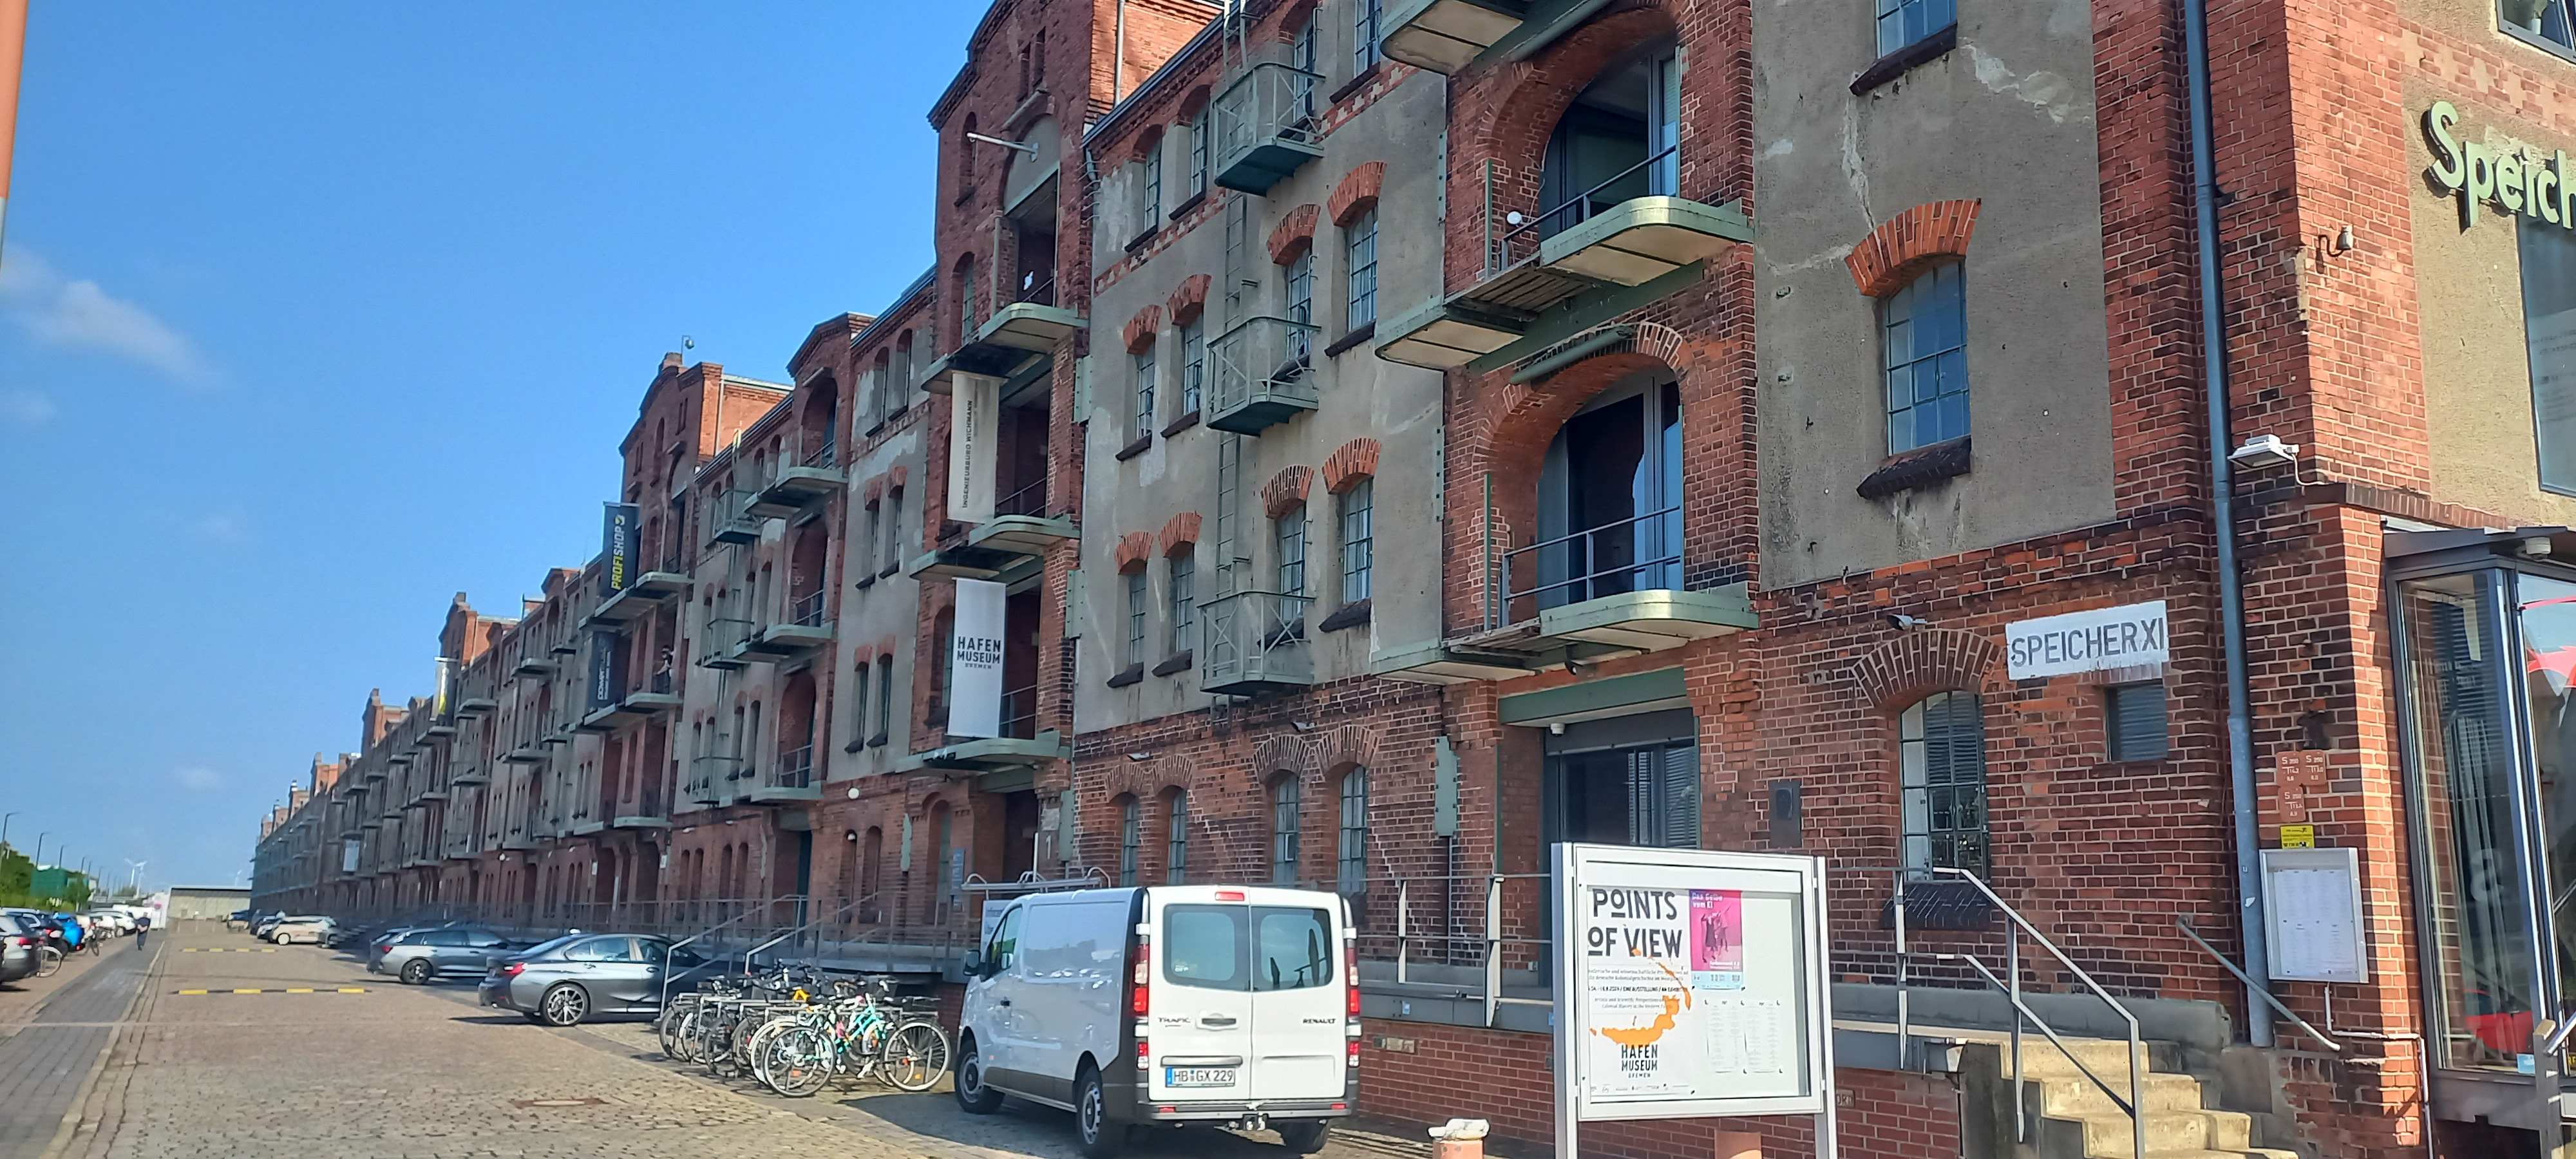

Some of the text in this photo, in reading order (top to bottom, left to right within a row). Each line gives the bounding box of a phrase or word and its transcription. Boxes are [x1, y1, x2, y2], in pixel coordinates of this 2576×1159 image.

[611, 525, 625, 590] PROFISHOP
[958, 636, 1001, 652] HAFEN
[957, 650, 1000, 664] MUSEUM
[1592, 888, 1678, 920] POINTS
[1588, 927, 1683, 958] OF VIEW
[1621, 1044, 1658, 1059] HAFEN
[1622, 1060, 1658, 1071] MUSEUM
[1174, 1070, 1233, 1082] HB GX 229
